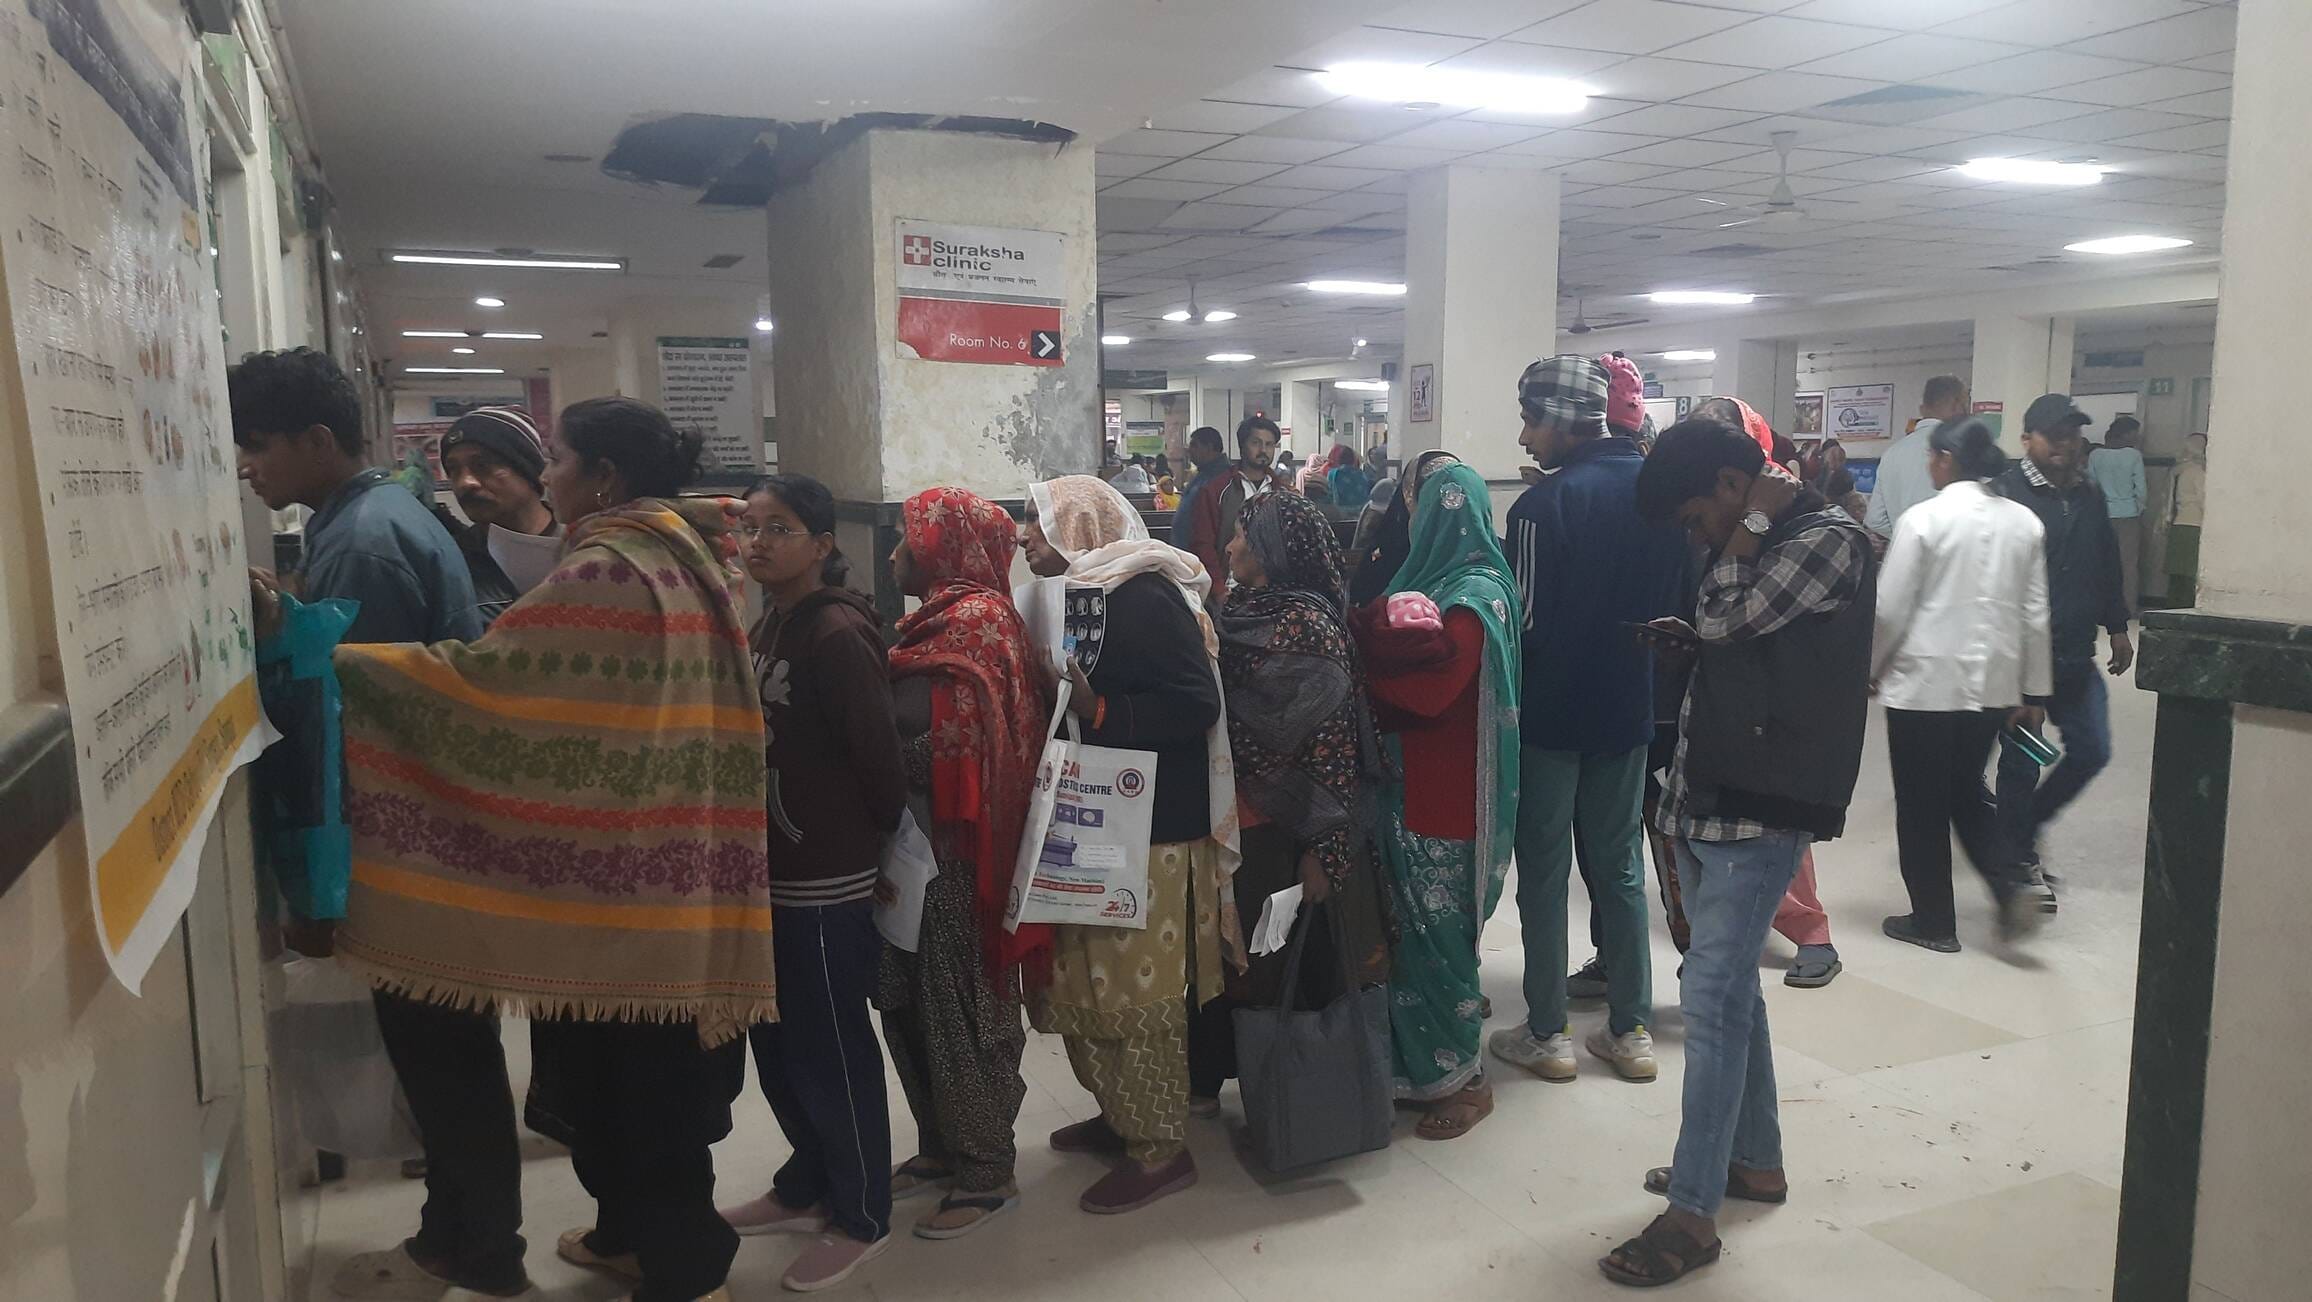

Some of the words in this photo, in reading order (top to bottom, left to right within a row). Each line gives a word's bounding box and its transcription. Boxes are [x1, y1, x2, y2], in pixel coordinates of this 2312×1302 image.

[933, 241, 1024, 261] Suraksha
[933, 255, 992, 271] clinic
[950, 333, 985, 348] Room
[990, 336, 1013, 349] No.
[1018, 337, 1026, 350] 6
[1679, 398, 1687, 416] 8
[1080, 784, 1112, 796] CENTRE
